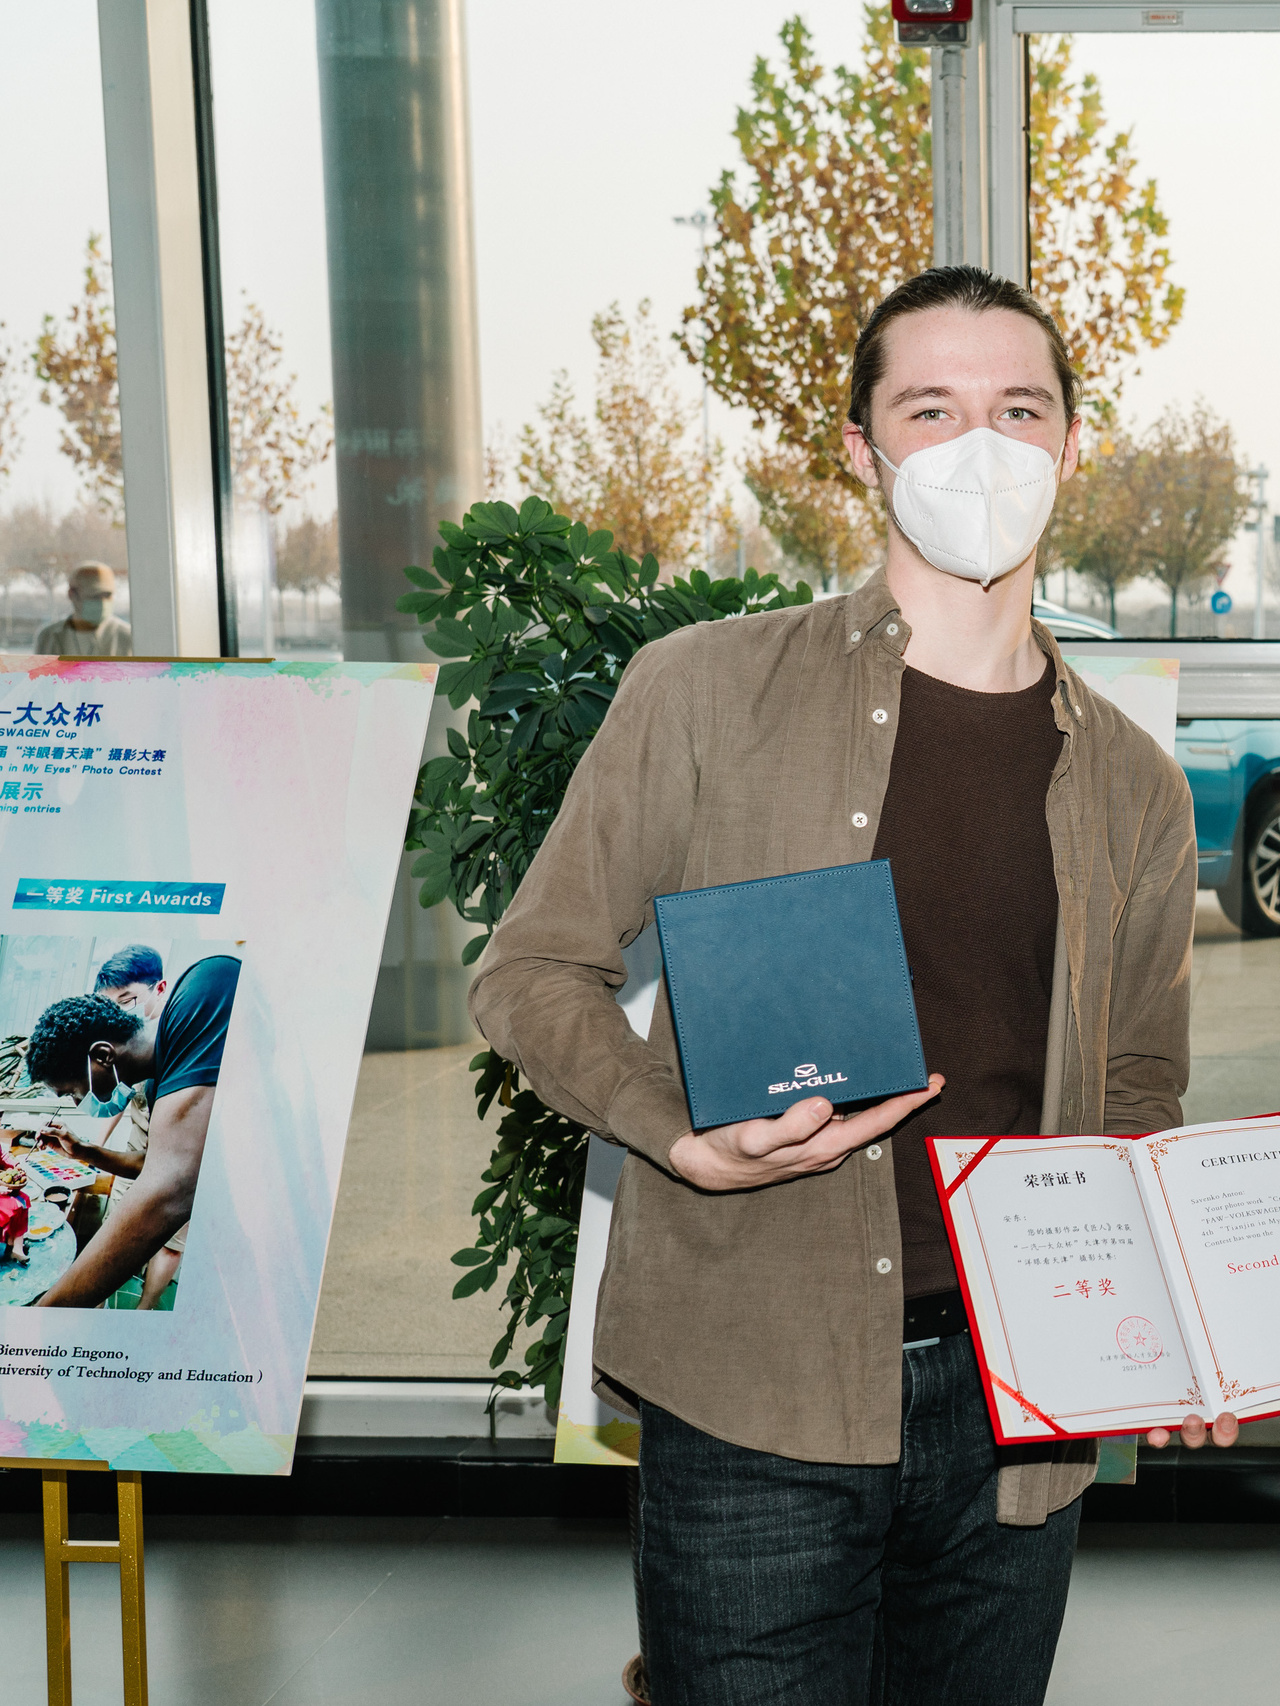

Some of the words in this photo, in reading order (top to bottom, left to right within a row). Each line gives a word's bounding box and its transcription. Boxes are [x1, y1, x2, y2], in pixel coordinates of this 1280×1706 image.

[56, 729, 77, 740] Cup
[8, 763, 18, 772] in
[22, 763, 39, 774] My
[82, 765, 113, 775] Photo
[119, 766, 162, 776] Contest
[0, 781, 44, 801] 展示
[24, 804, 61, 814] entries
[26, 886, 83, 905] 一等奖
[90, 888, 133, 905] First
[138, 890, 212, 907] Awards
[768, 1072, 848, 1094] SEA-GULL
[1024, 1170, 1087, 1188] 荣誉证书
[1190, 1194, 1220, 1205] Savenko
[1205, 1204, 1223, 1213] Your
[1224, 1201, 1245, 1212] photo
[1246, 1197, 1264, 1206] work
[1201, 1229, 1215, 1237] 4th
[1268, 1217, 1280, 1226] My
[1204, 1237, 1232, 1248] Contest
[1233, 1234, 1245, 1242] has
[1262, 1229, 1274, 1237] the
[1227, 1255, 1279, 1275] Second
[1052, 1278, 1118, 1299] 二等奖
[57, 1365, 75, 1377] of
[76, 1366, 153, 1382] Technology
[158, 1369, 182, 1381] and
